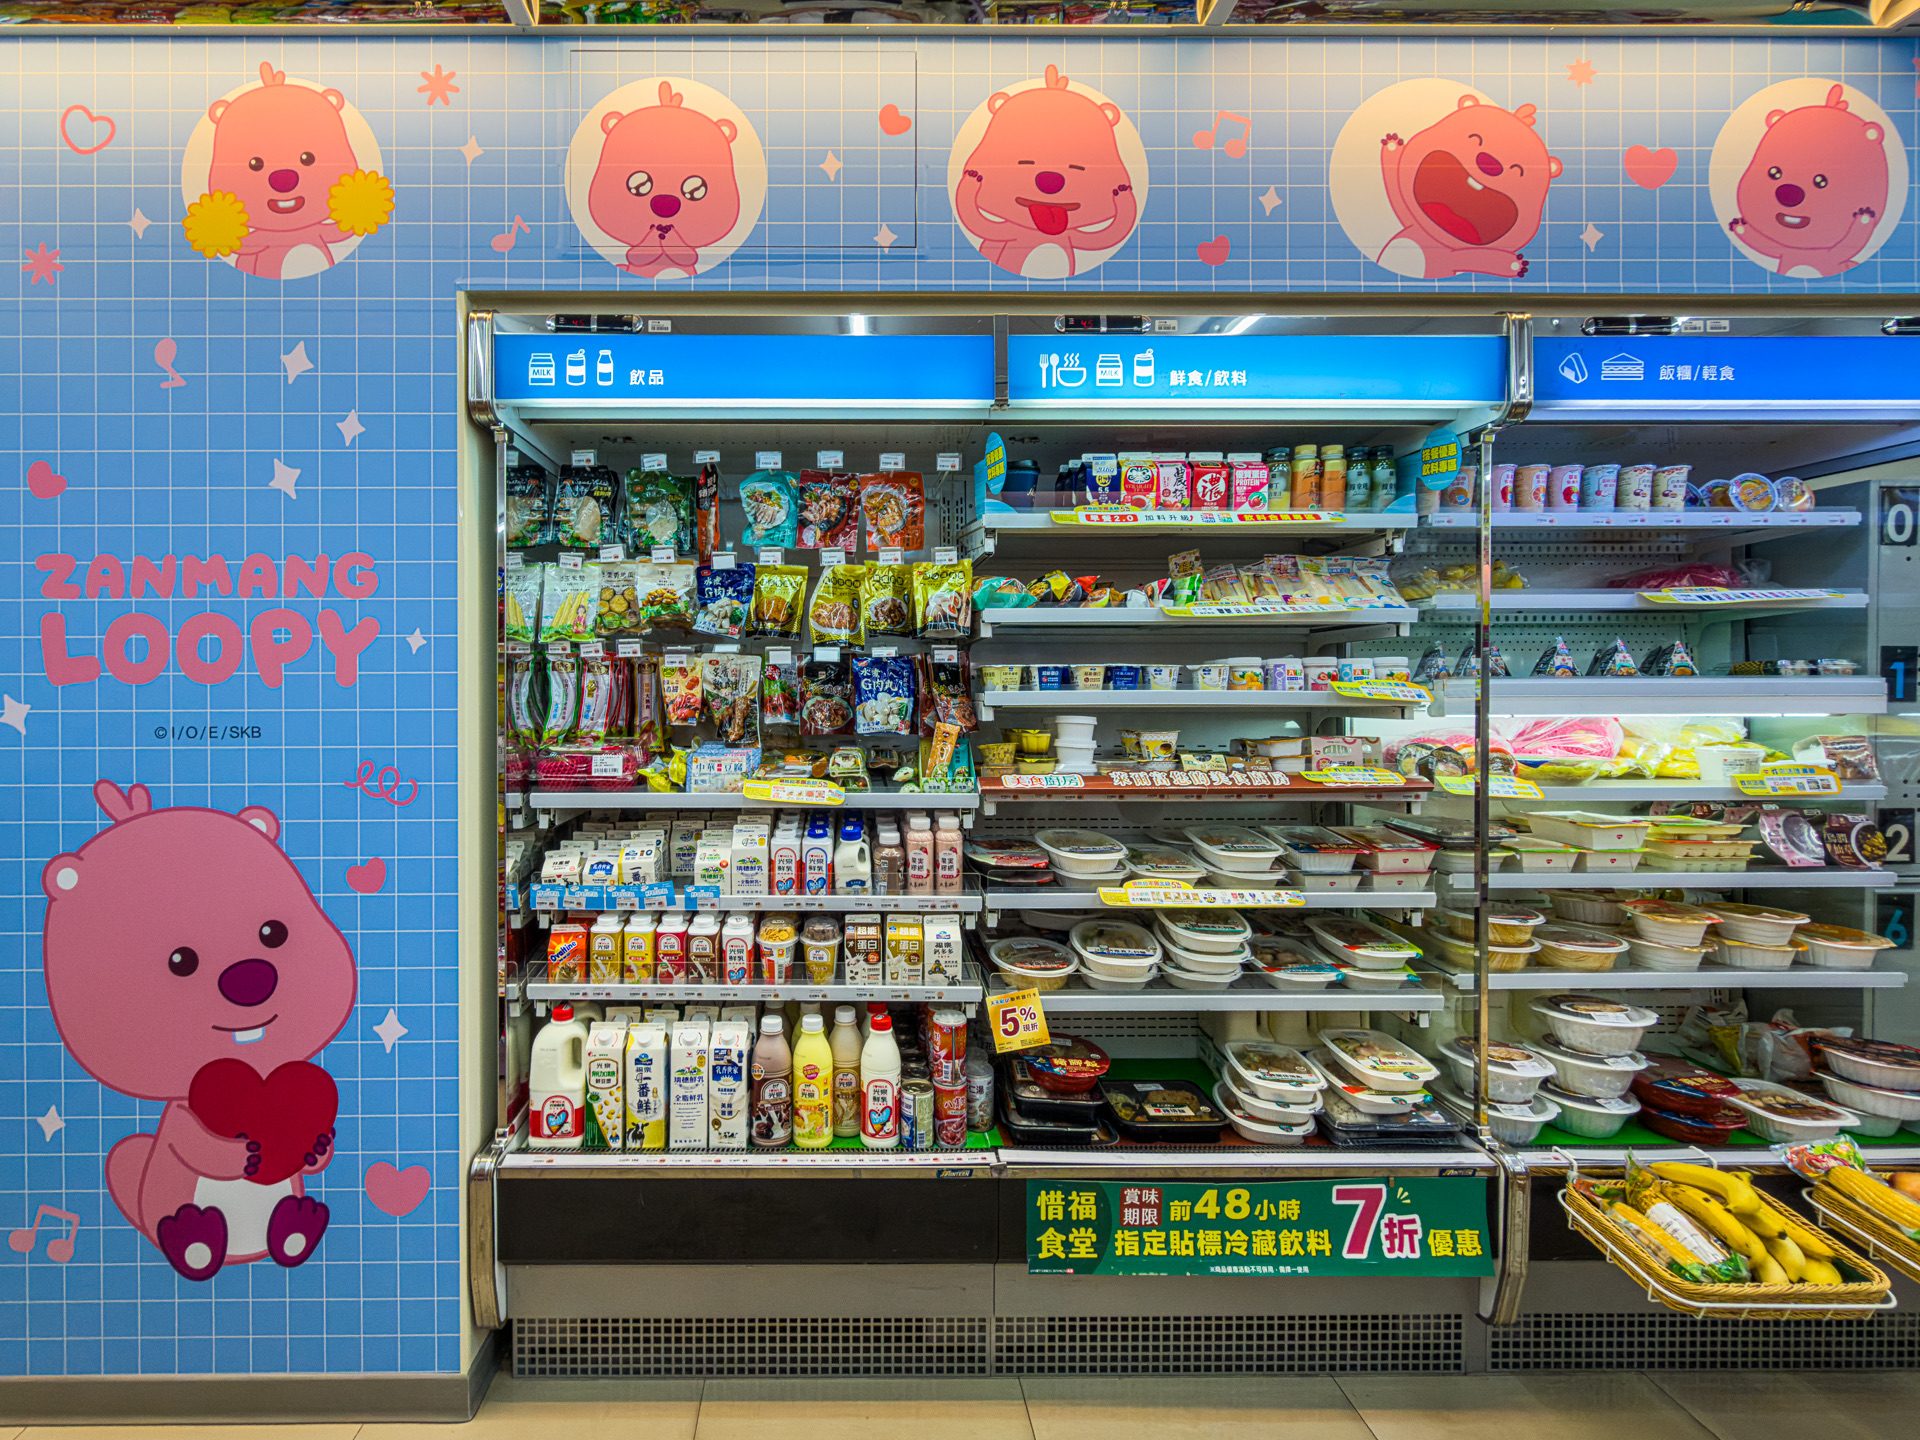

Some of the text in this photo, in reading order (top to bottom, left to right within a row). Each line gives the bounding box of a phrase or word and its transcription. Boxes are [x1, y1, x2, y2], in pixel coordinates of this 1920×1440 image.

[532, 368, 552, 377] MILK
[629, 369, 664, 386] 飲品
[1099, 369, 1120, 377] MILK
[1169, 369, 1247, 387] 鮮食/飲料
[1659, 364, 1735, 382] 飯糰/輕食
[1886, 503, 1914, 543] 0
[35, 552, 379, 600] ZANMANG
[41, 608, 381, 689] LOOPY
[861, 678, 899, 692] G肉丸
[1889, 661, 1906, 700] 1
[1885, 823, 1910, 862] 2
[1884, 909, 1908, 944] 6
[549, 941, 578, 963] Ovaltine
[1000, 1005, 1037, 1038] 5%
[674, 1075, 704, 1083] 瑞穗鮮乳
[675, 1093, 704, 1102] 全脂鮮乳
[1036, 1190, 1098, 1221] 惜福
[1122, 1188, 1160, 1206] 賞味
[1169, 1187, 1301, 1222] 前48小時
[1122, 1207, 1159, 1226] 期限
[1332, 1184, 1421, 1260] 7折
[1036, 1226, 1099, 1260] 食堂
[1114, 1228, 1333, 1257] 指定貼標冷藏飲料
[1427, 1228, 1483, 1257] 優惠
